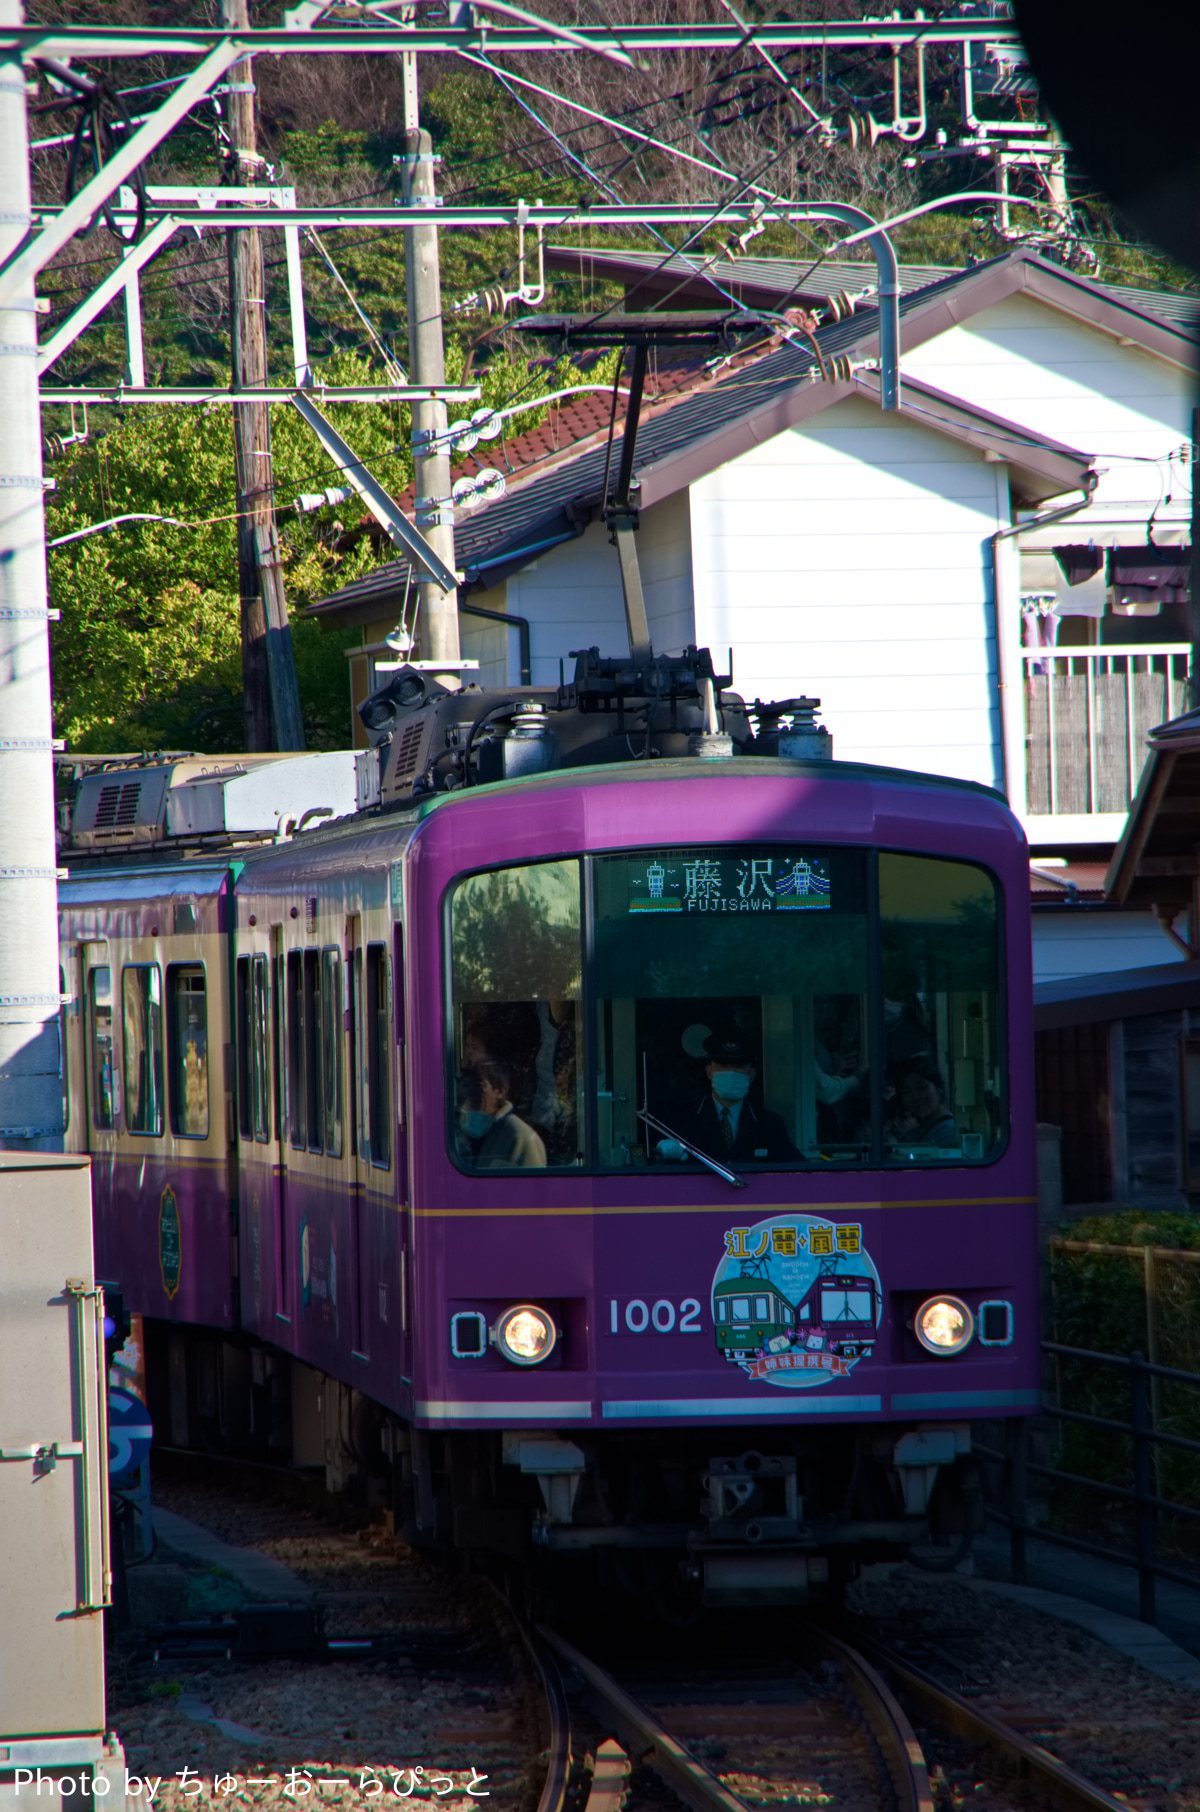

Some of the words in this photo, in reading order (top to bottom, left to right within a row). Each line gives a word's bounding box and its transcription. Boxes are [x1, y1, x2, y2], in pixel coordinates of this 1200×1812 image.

[682, 858, 775, 899] 藤沢
[687, 898, 772, 912] FUJISAWA
[610, 1298, 702, 1334] 1002
